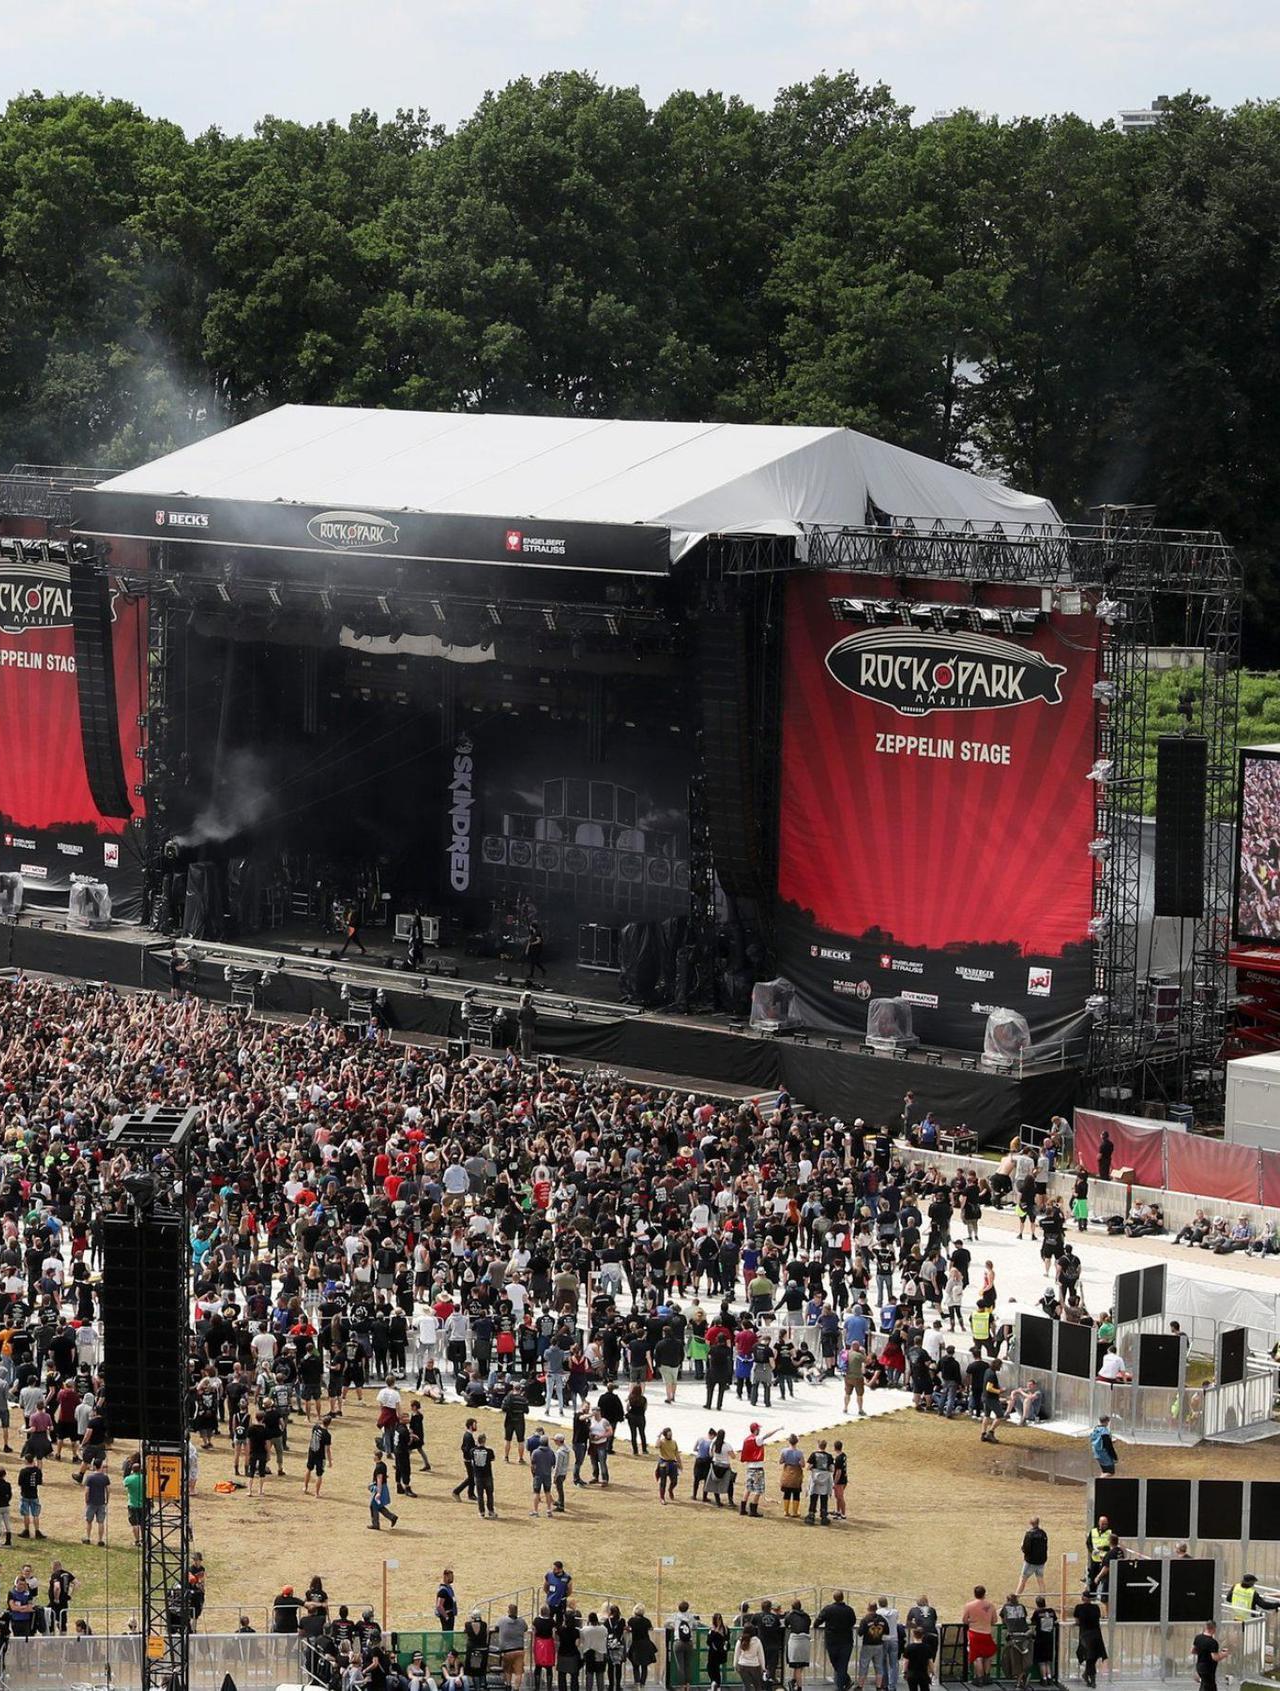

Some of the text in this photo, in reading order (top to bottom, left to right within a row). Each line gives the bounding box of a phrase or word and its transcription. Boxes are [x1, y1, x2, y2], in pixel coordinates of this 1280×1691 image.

[169, 513, 209, 526] BECK'S
[320, 523, 384, 542] ROCK PARK
[523, 537, 566, 546] ENGELBERT
[523, 545, 566, 554] STRAUSS
[46, 653, 77, 673] STAG
[860, 653, 1026, 700] ROCK PARK
[875, 733, 1011, 765] ZEPPELIN STAGE
[446, 755, 475, 892] SKINDRED
[892, 964, 924, 974] STRAUSS
[1030, 972, 1050, 989] NRJ
[159, 1474, 170, 1493] 7
